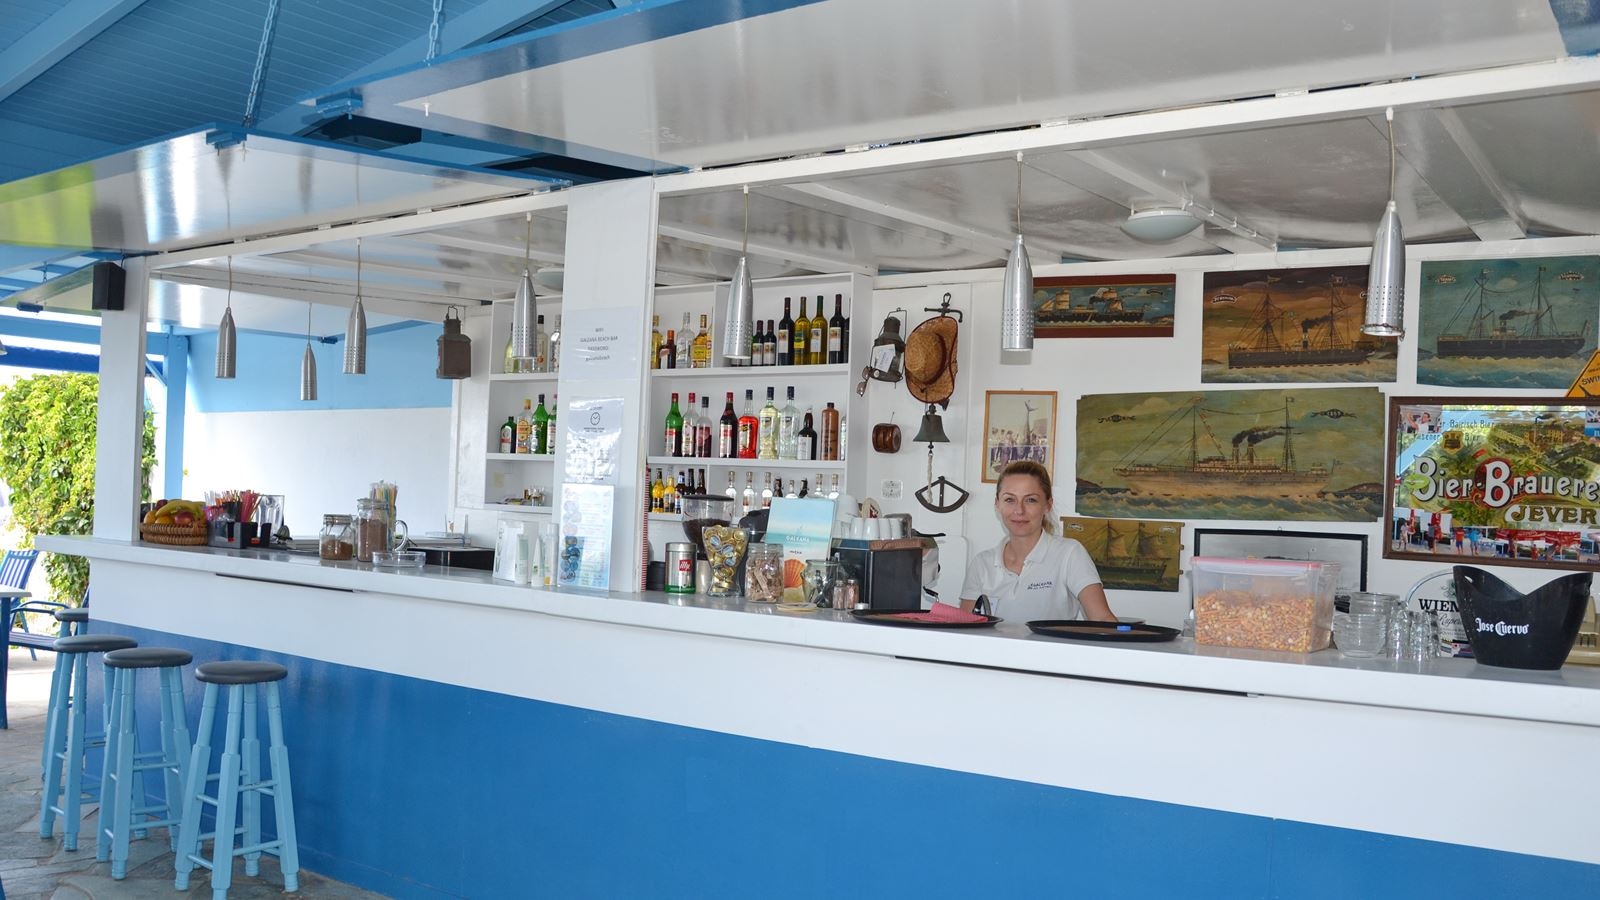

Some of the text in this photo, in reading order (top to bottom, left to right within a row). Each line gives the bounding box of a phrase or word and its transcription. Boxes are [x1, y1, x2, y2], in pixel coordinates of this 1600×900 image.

[1511, 504, 1598, 525] JEVER
[1475, 617, 1494, 633] Jose
[1495, 621, 1530, 636] Cuervo
